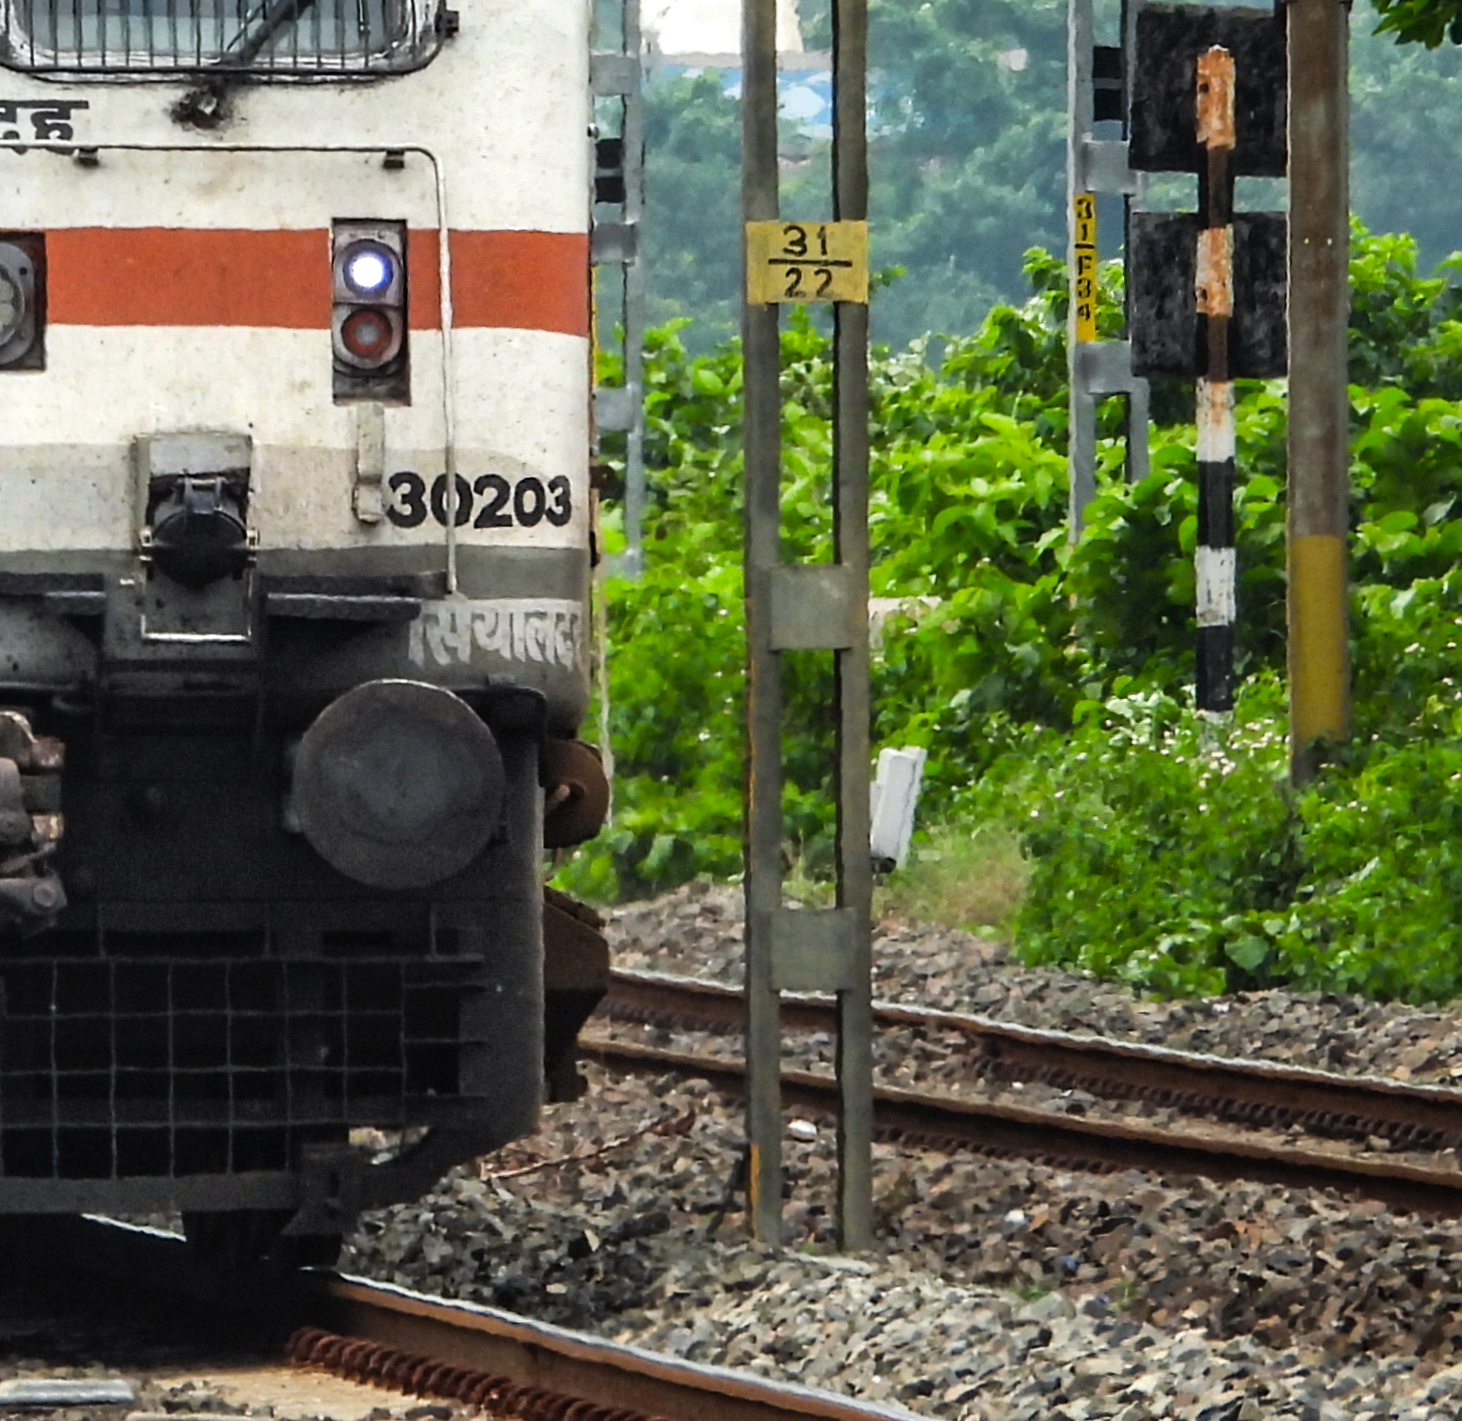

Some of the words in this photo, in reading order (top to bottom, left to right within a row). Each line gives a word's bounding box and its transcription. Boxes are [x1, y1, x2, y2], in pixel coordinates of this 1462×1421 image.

[783, 225, 827, 256] 31
[784, 267, 833, 298] 22
[386, 471, 572, 528] 30203
